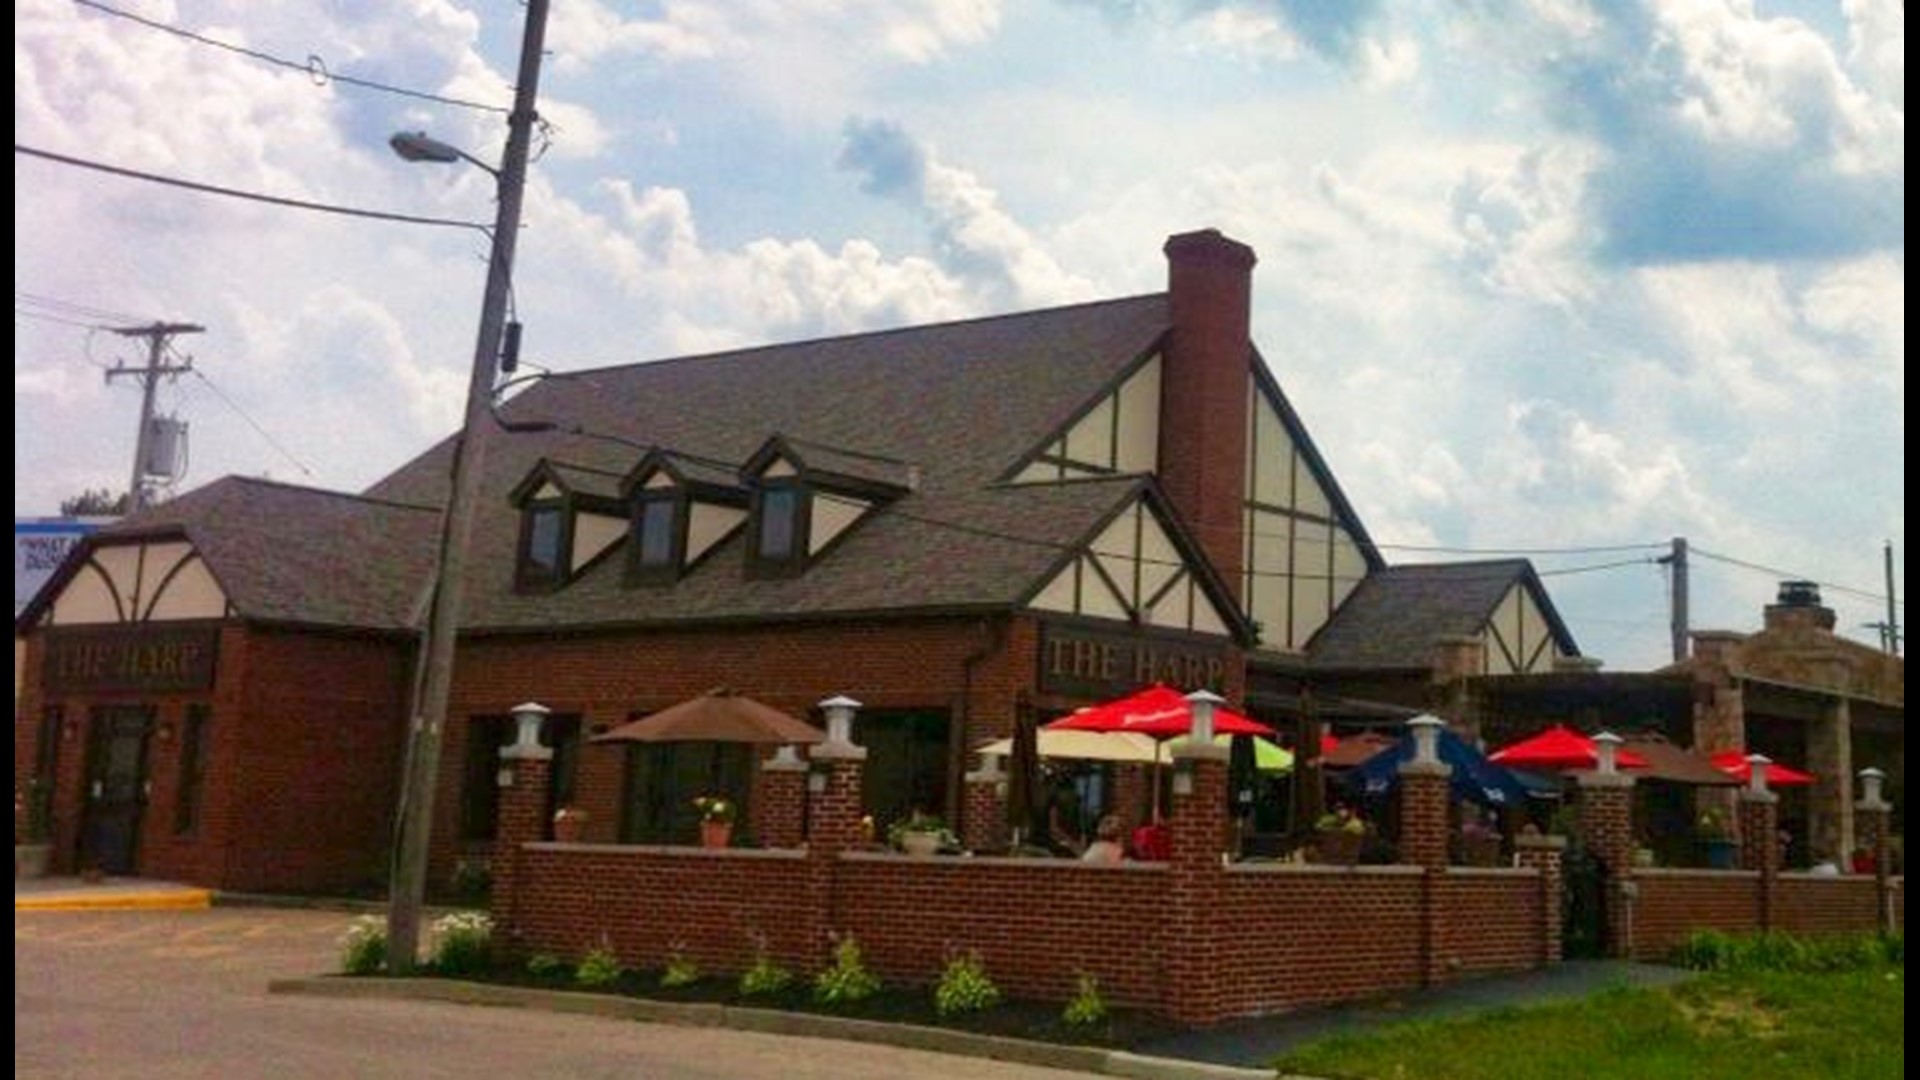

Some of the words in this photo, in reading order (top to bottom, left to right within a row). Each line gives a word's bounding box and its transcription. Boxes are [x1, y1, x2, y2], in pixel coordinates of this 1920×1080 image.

[57, 643, 110, 675] THE
[121, 643, 201, 675] HARP
[1050, 638, 1116, 679] THE
[1137, 644, 1223, 688] HARP
